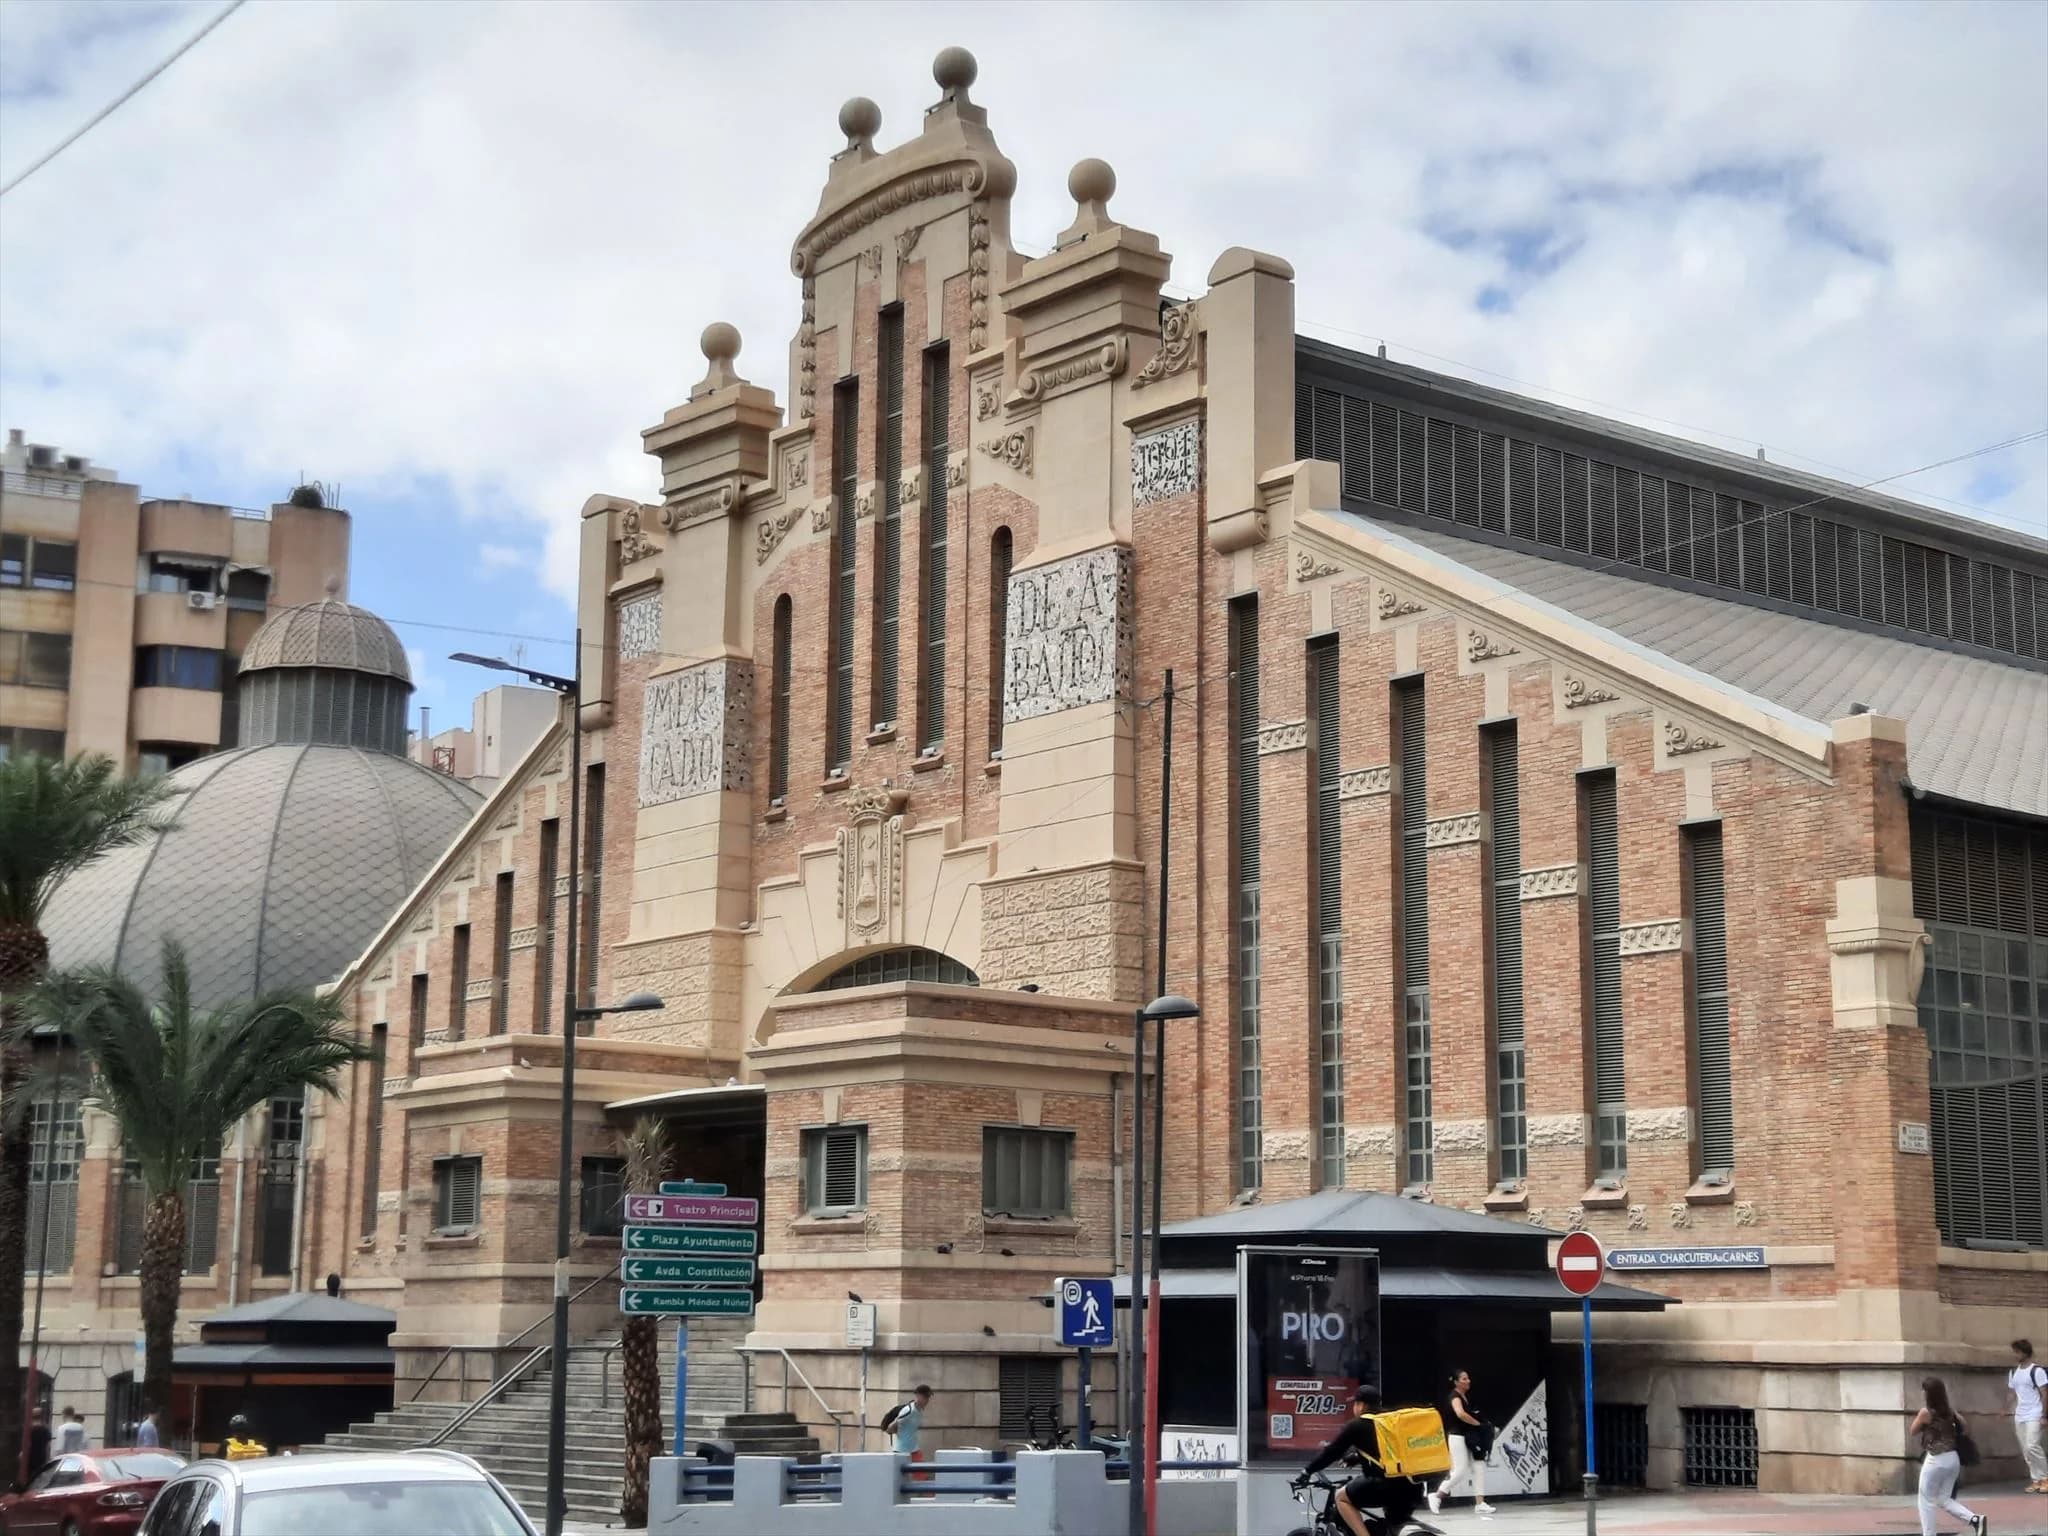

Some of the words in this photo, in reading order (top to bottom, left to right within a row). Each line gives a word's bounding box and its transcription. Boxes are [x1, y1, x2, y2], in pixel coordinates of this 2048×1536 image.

[674, 1204, 706, 1215] Teatro
[710, 1206, 754, 1217] Principal
[652, 1235, 679, 1245] Plaza
[682, 1236, 753, 1248] Ayuntamiento
[1617, 1254, 1657, 1264] ENTRADA
[1722, 1251, 1760, 1262] CARNES
[655, 1266, 681, 1276] Avda
[687, 1266, 751, 1277] Constitución
[653, 1297, 685, 1306] Rambla
[688, 1297, 720, 1306] Méndez
[723, 1297, 750, 1307] Núñez
